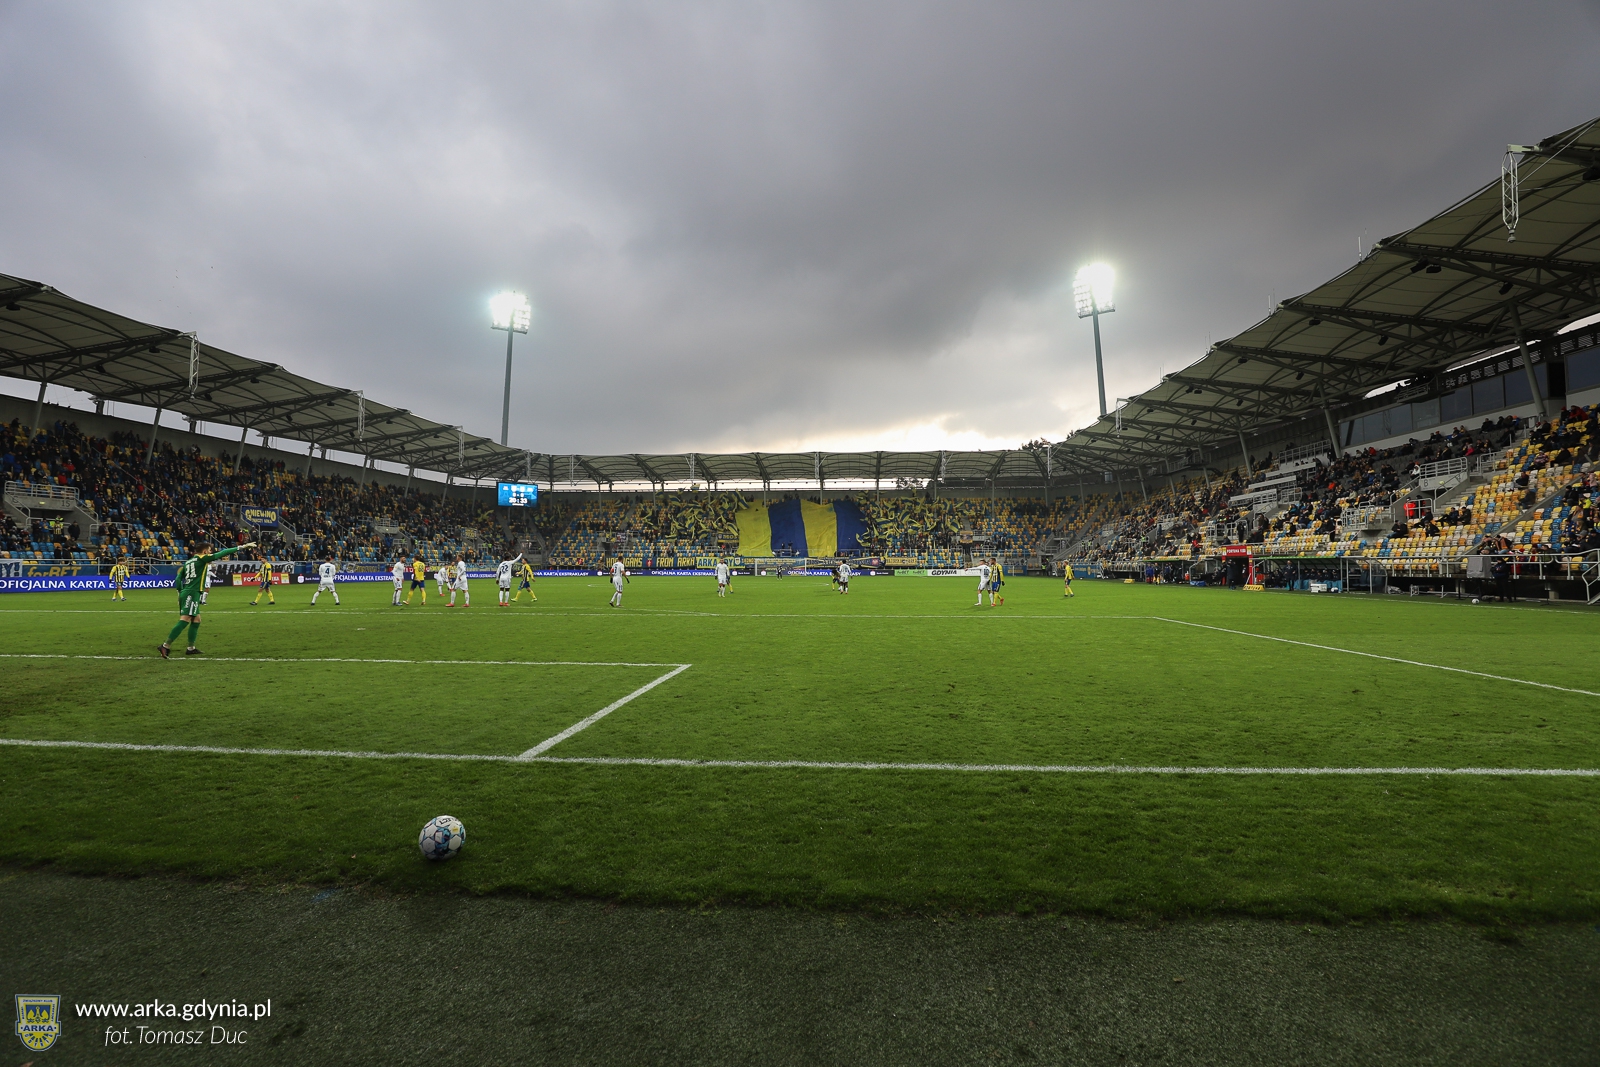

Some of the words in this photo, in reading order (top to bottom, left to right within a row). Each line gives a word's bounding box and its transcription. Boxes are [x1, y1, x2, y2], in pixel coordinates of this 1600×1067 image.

[656, 557, 674, 567] FROM
[698, 558, 717, 567] ARKA
[0, 580, 67, 591] OFICJALNA
[70, 580, 106, 589] KARTA
[109, 580, 175, 589] ESTRAKLASY
